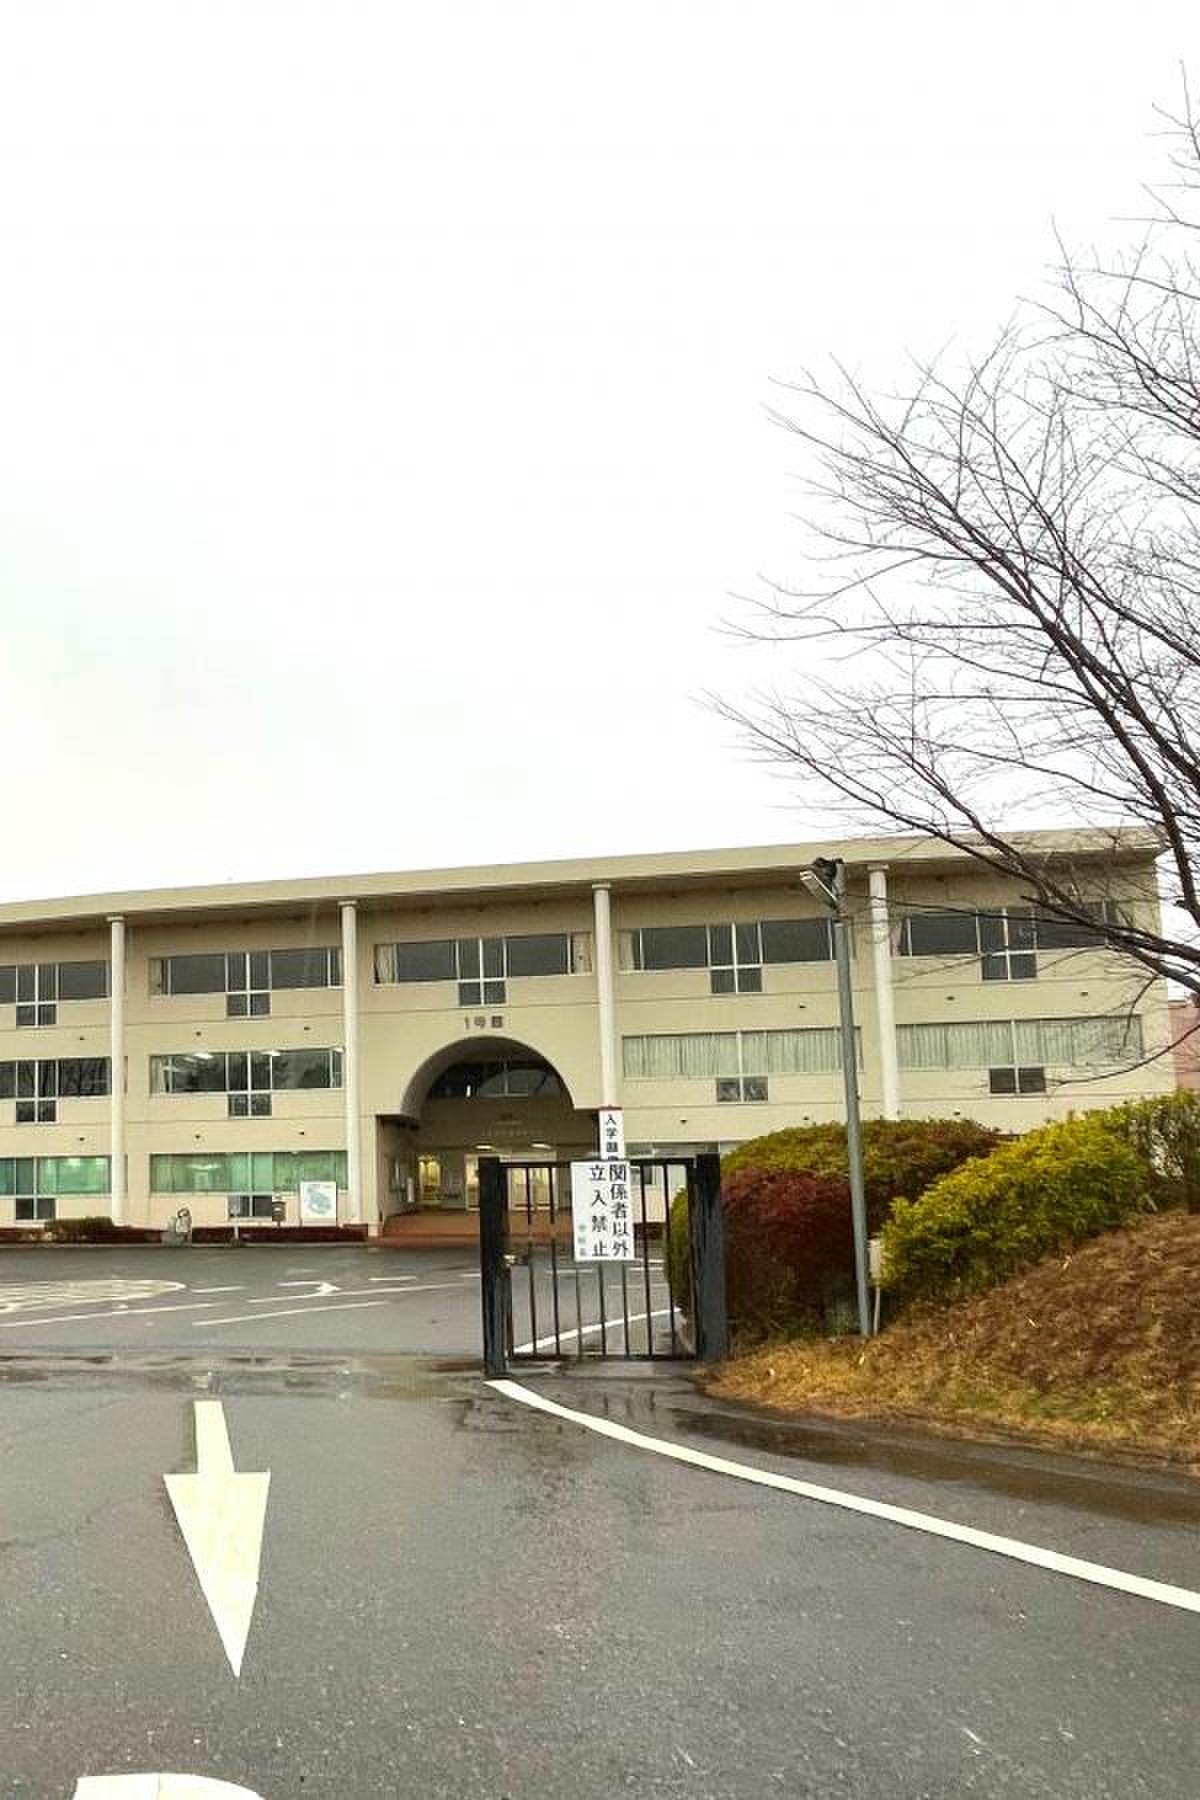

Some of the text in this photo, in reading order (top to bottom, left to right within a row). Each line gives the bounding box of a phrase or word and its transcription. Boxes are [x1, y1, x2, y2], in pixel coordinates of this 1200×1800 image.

[589, 1164, 608, 1257] 立入禁止
[609, 1164, 629, 1257] 関係者以外
